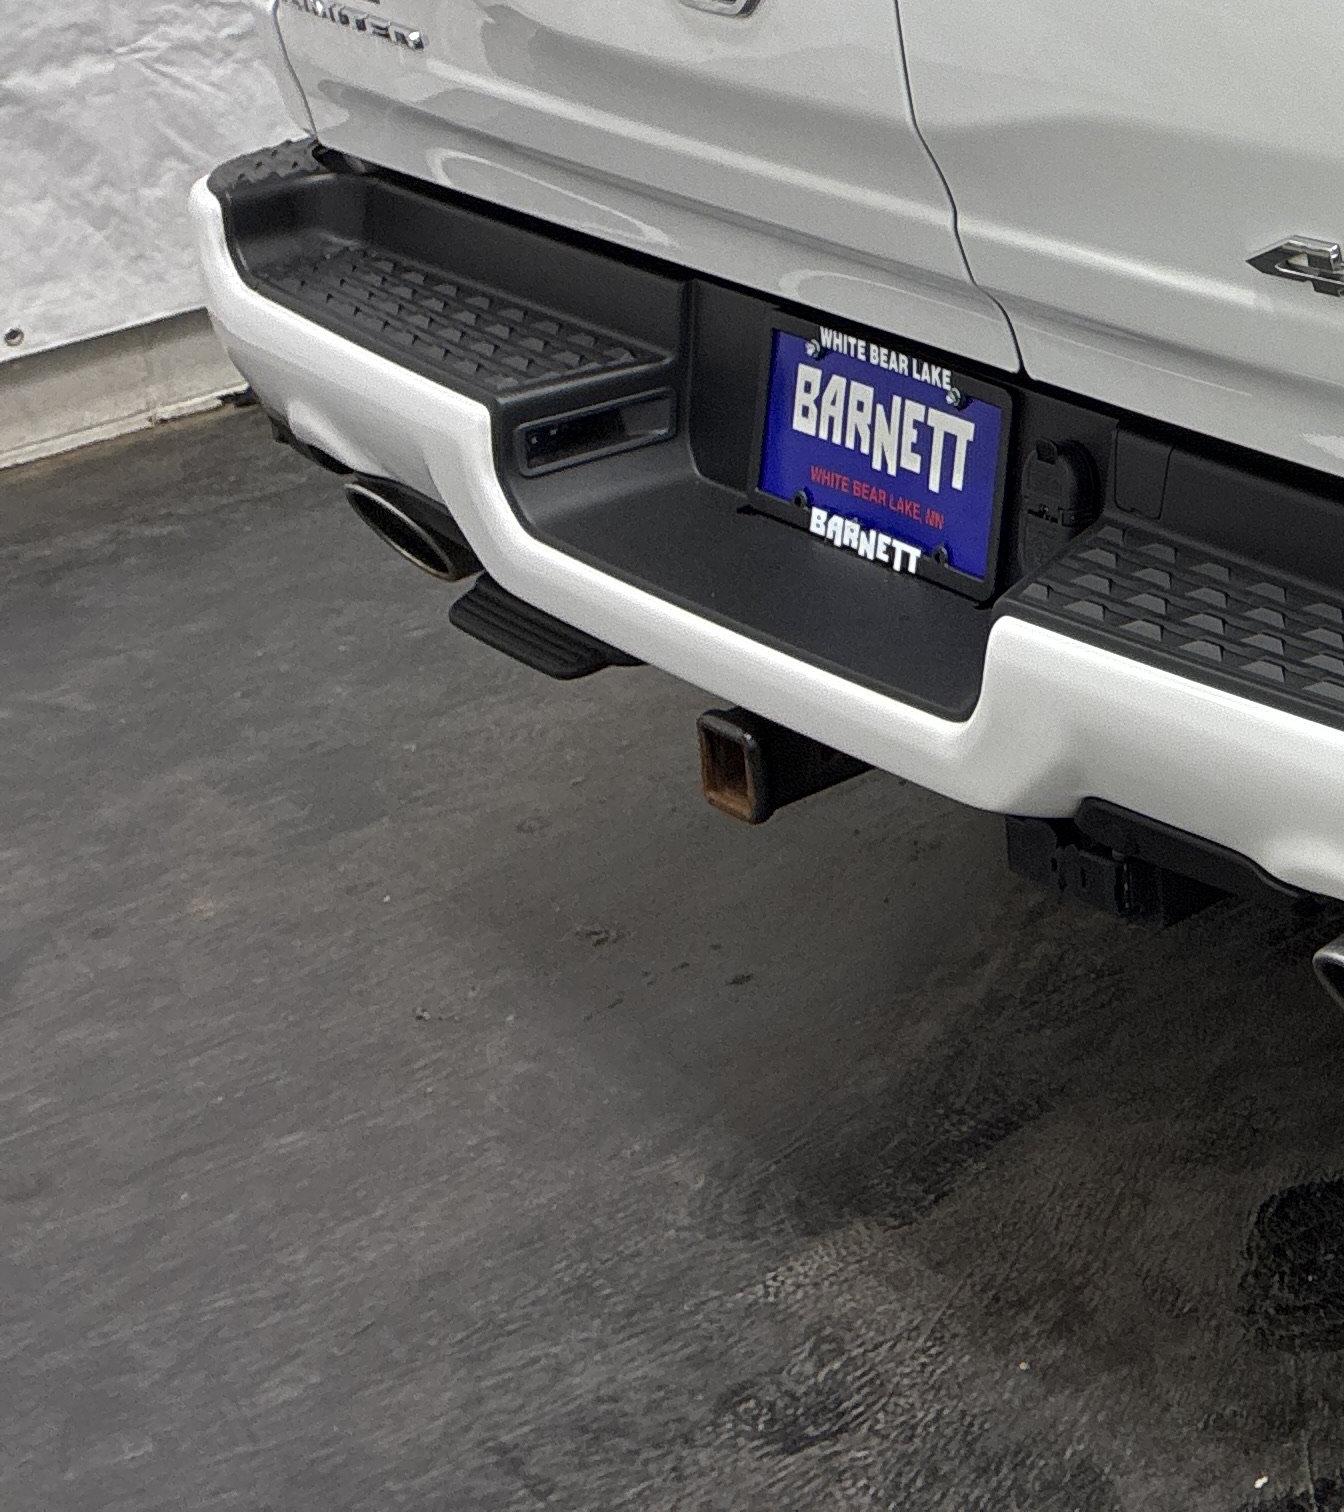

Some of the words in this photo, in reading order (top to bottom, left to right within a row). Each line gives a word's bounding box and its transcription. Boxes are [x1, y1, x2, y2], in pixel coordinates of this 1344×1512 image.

[819, 325, 867, 362] WHITE
[869, 342, 909, 376] BEAR
[912, 356, 952, 390] LAKE
[792, 363, 976, 494] BARNETT
[810, 465, 850, 494] WHITE
[852, 479, 887, 506] BEAR
[889, 493, 923, 524] LAKE,
[809, 506, 922, 574] BARNETT
